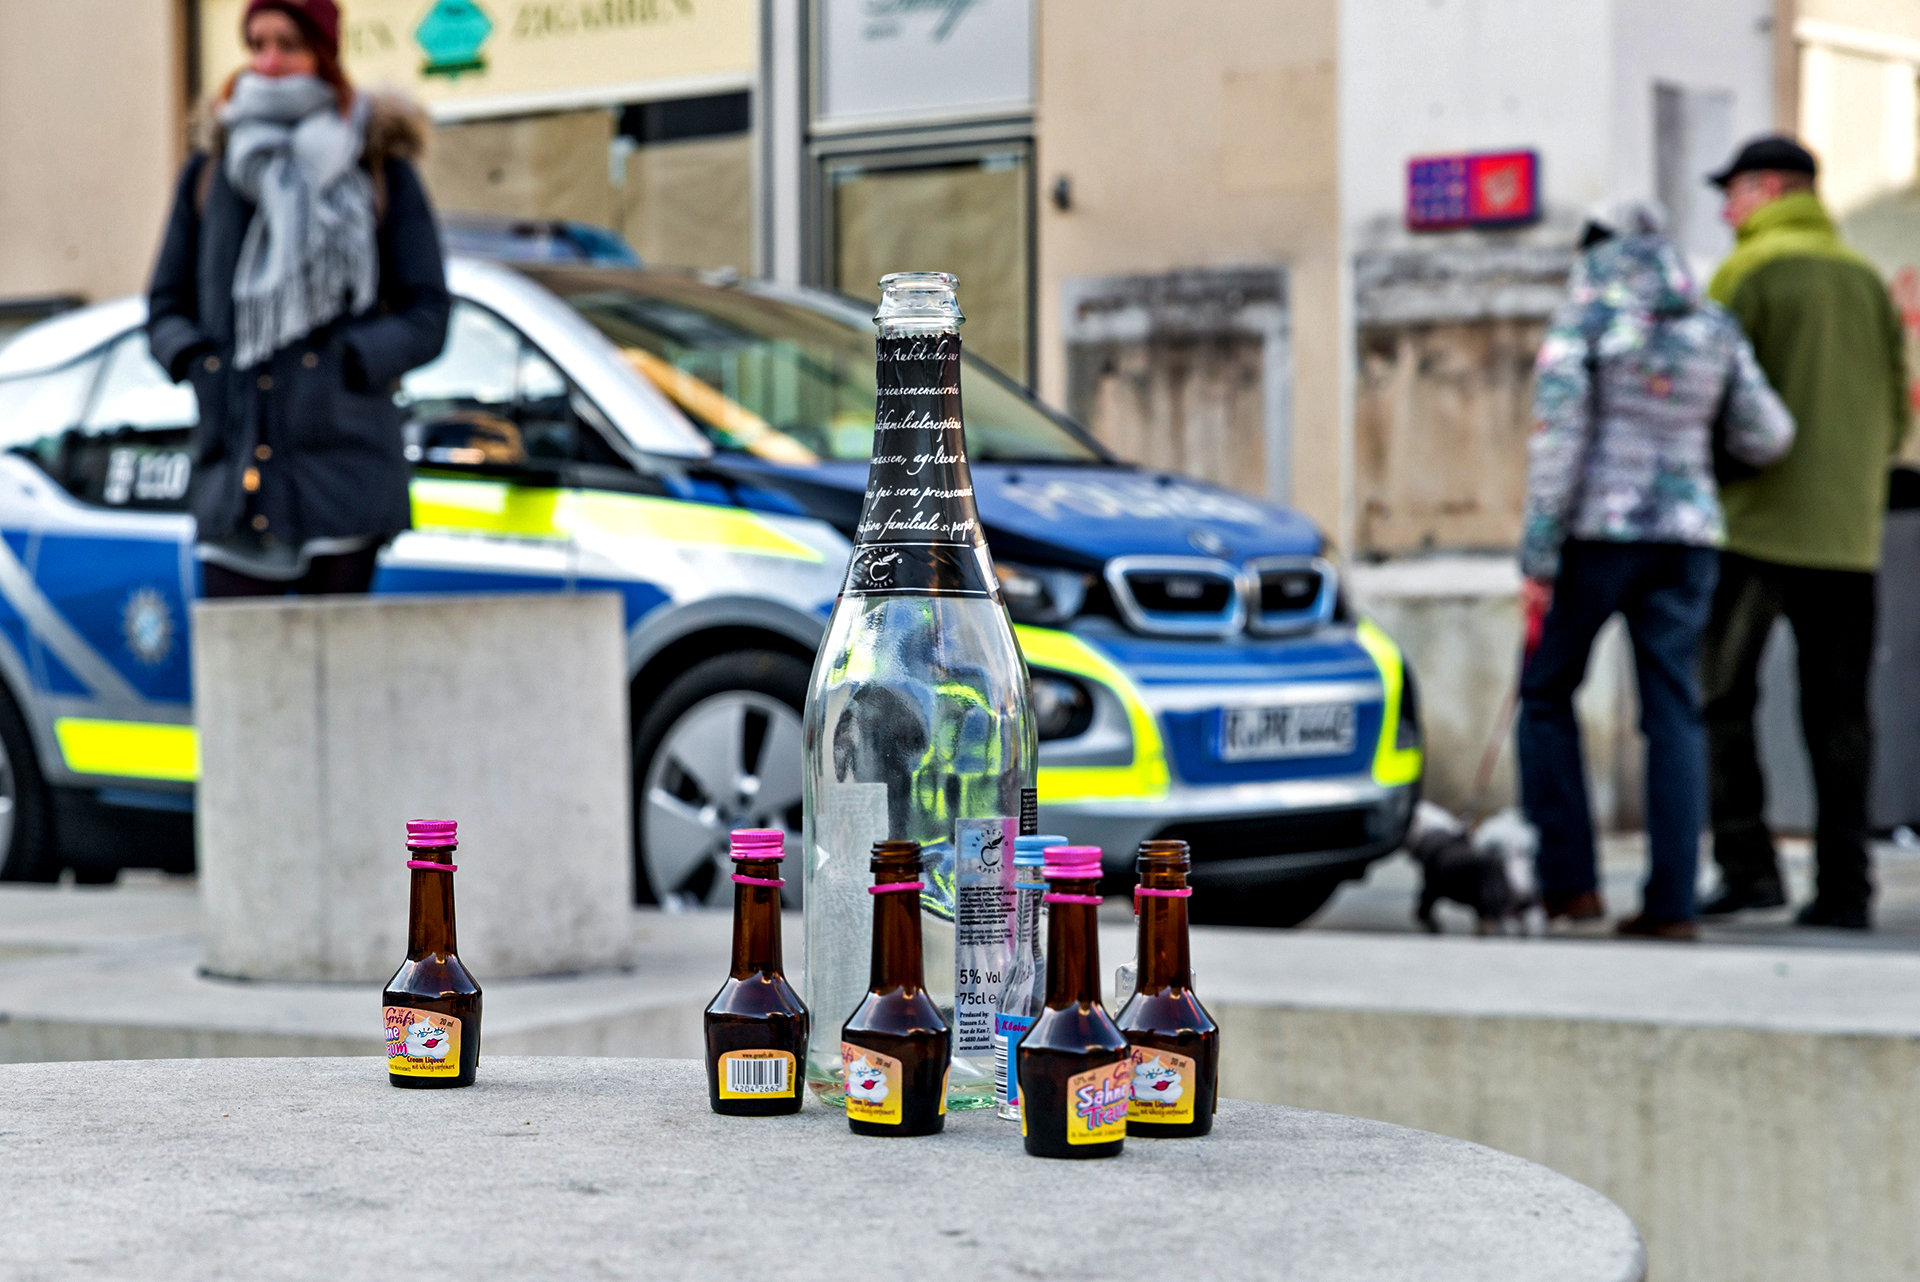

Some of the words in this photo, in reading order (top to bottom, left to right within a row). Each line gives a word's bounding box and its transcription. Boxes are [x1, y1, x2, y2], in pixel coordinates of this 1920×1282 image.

[894, 487, 921, 498] sera
[877, 509, 939, 540] familiale
[960, 969, 981, 985] 5%
[960, 992, 986, 1006] 75cl
[425, 1057, 445, 1065] Liqueur
